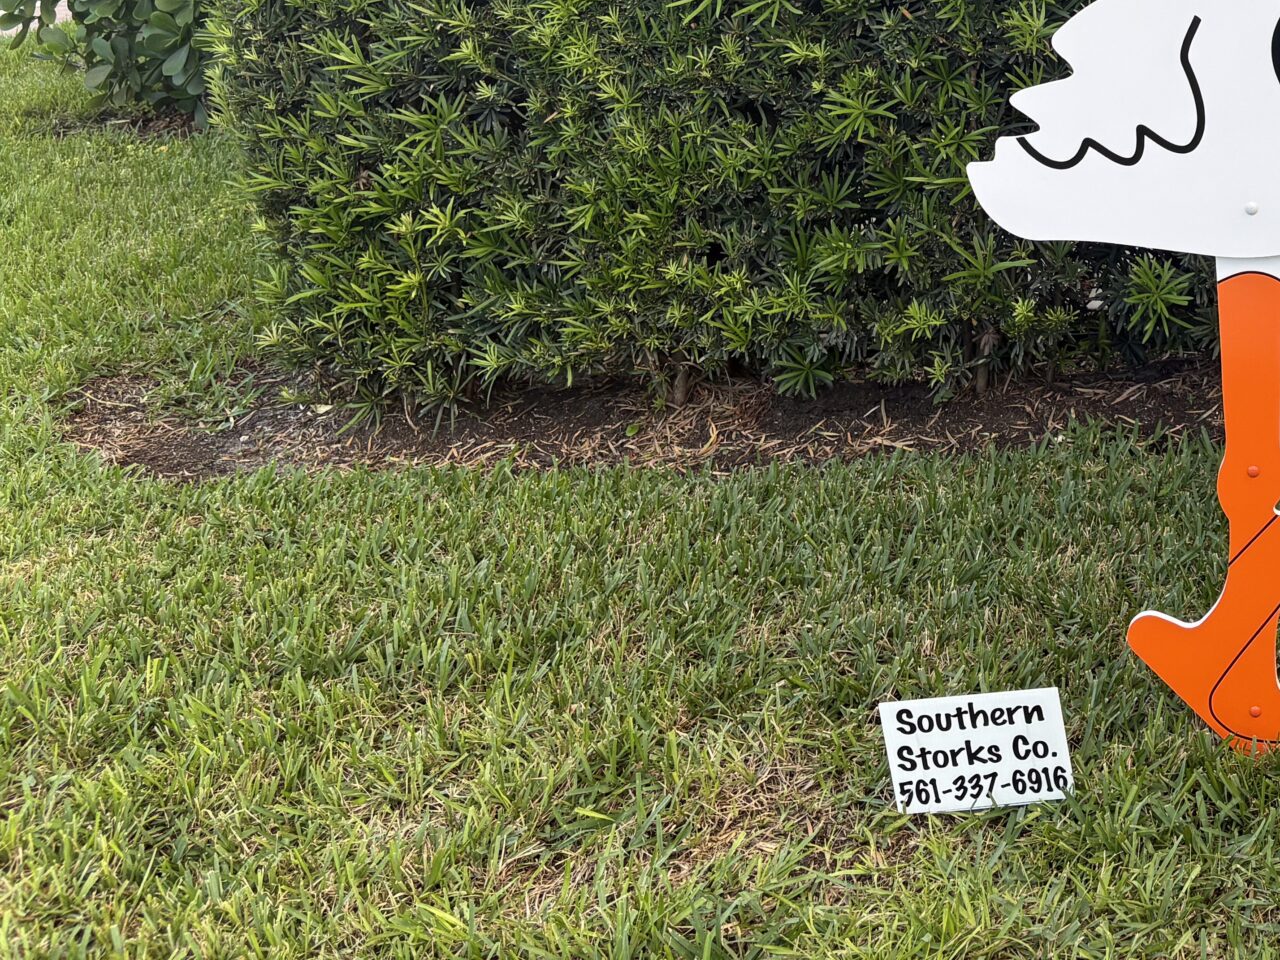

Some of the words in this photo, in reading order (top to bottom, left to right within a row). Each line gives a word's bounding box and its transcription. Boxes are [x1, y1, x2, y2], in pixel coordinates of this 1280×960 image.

[896, 702, 1045, 735] Southern
[897, 740, 1003, 771] Storks
[1012, 735, 1058, 761] Co.
[899, 765, 1068, 808] 561-337-6916
